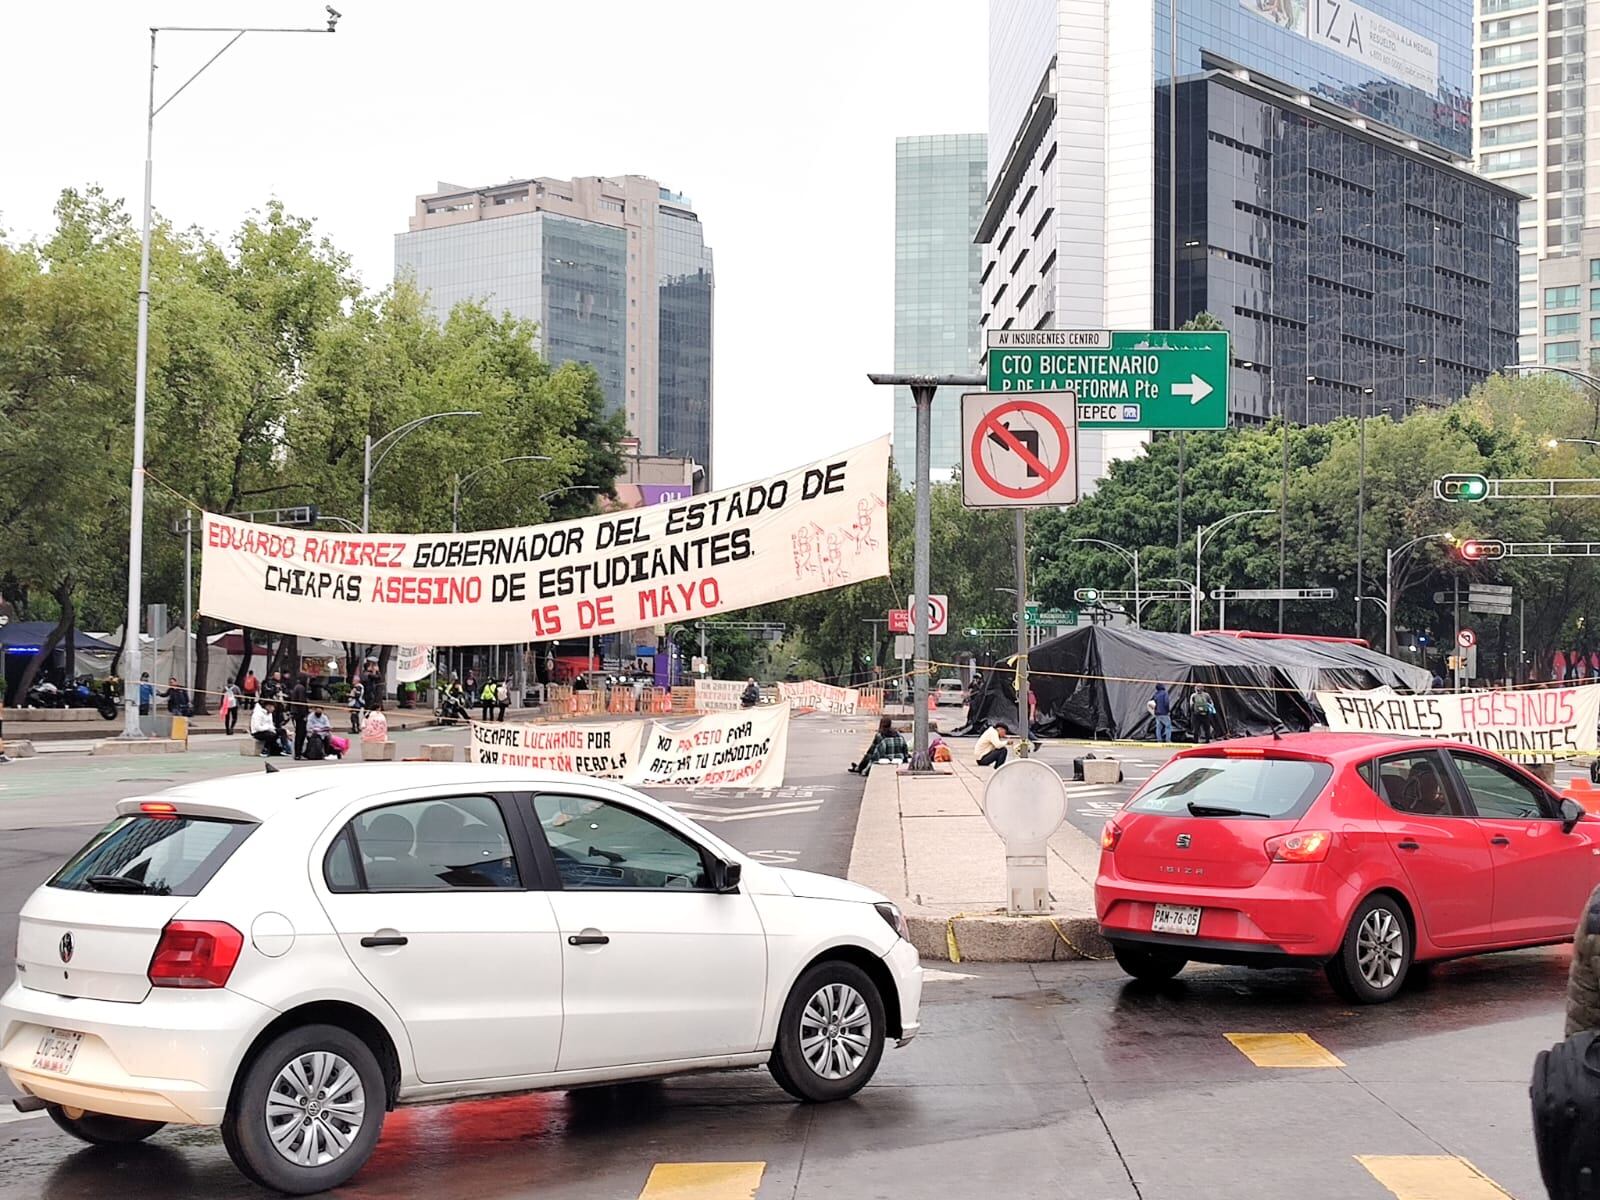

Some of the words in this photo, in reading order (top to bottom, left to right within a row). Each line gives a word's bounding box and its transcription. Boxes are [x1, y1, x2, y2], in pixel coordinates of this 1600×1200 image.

[999, 333, 1009, 344] AV
[1012, 333, 1065, 344] INSURGENTES
[1069, 333, 1099, 345] CENTRO
[1002, 355, 1032, 375] CTO
[1040, 355, 1159, 375] BICENTENARIO
[1017, 379, 1034, 391] DE
[1042, 379, 1058, 391] LA
[1065, 378, 1129, 399] REFORMA
[1135, 379, 1159, 399] Pte
[208, 522, 295, 559] EDUARDO
[303, 538, 406, 568] RAMIREZ
[413, 527, 584, 568] GOBERNADOR
[596, 516, 650, 551] DEL
[665, 480, 788, 536] ESTADO
[802, 461, 847, 501] DE
[371, 576, 482, 605] ASESINO
[492, 572, 526, 602] DE
[539, 528, 755, 599] ESTUDIANTES.
[532, 604, 561, 636] 15
[578, 595, 615, 630] DE
[639, 577, 723, 620] MAYO.
[1335, 696, 1443, 730] PAKALES
[1460, 690, 1576, 729] ASESINOS
[523, 730, 583, 750] LUCHAMOS
[587, 731, 611, 749] POR
[695, 752, 710, 771] TU
